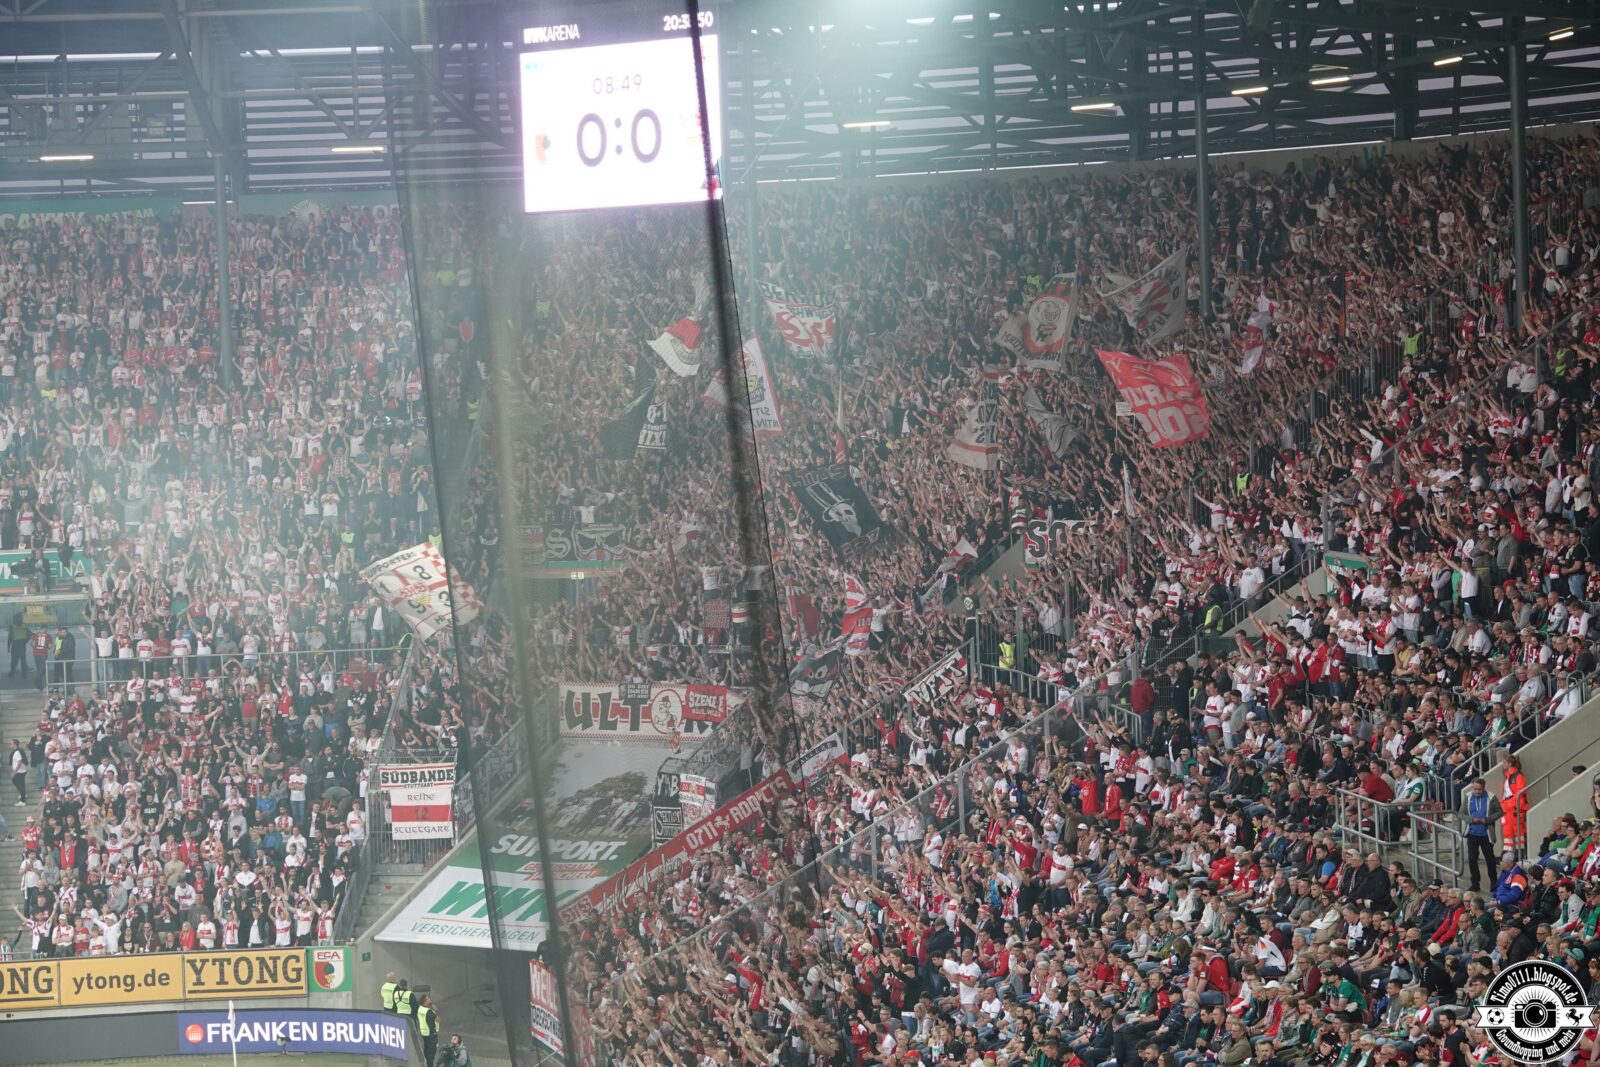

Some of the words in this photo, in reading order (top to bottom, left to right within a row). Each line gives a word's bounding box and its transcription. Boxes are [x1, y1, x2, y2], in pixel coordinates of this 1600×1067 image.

[592, 73, 643, 95] 08:49
[577, 108, 662, 167] 0:0
[381, 768, 454, 784] SÜDBANDE
[685, 820, 720, 851] 0711
[316, 950, 341, 961] FCA
[72, 968, 171, 995] ytong.de
[186, 954, 303, 986] YTONG
[206, 1020, 319, 1044] FRANKEN
[322, 1021, 406, 1050] BRUNNEN
